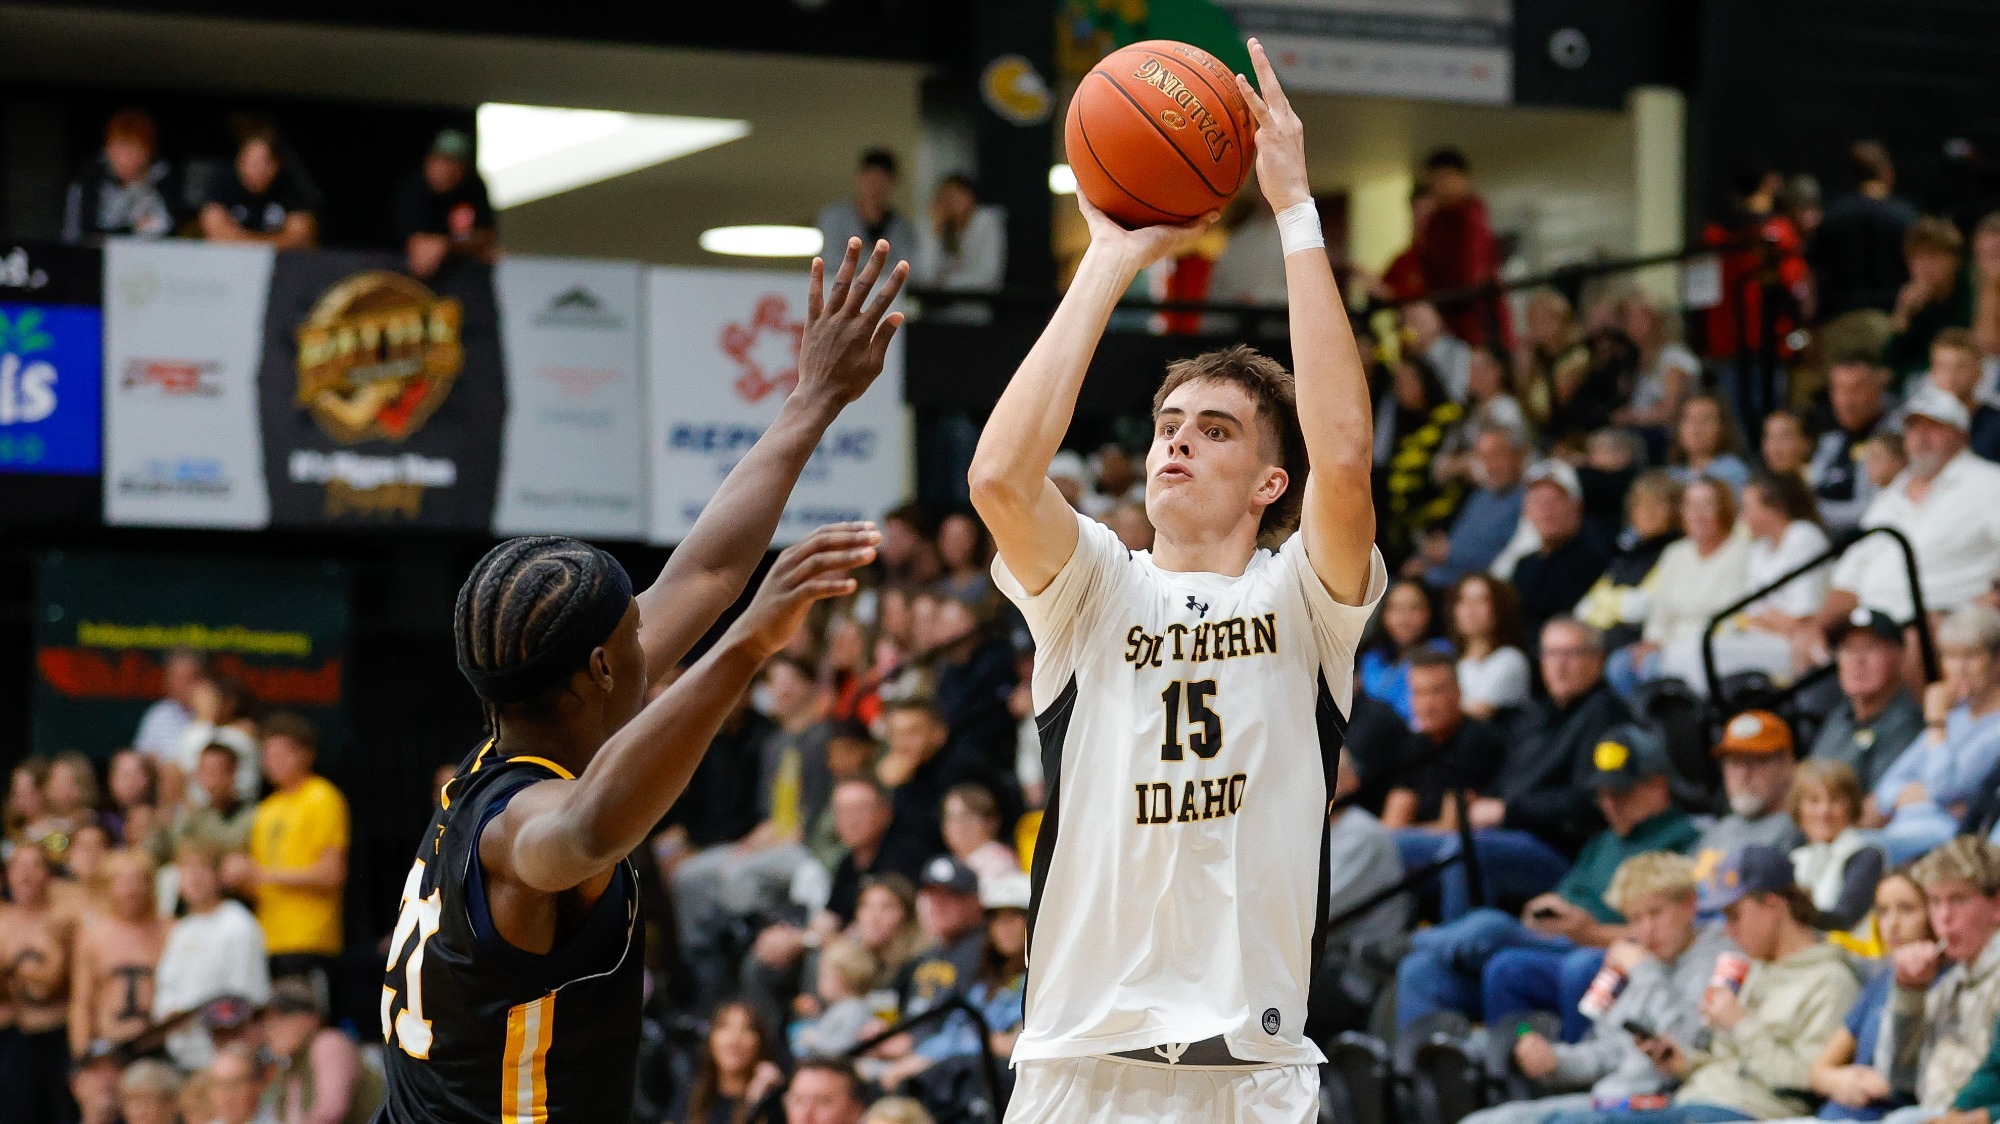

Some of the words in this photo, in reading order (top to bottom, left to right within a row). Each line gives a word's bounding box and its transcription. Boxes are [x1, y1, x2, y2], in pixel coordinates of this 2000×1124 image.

[1133, 57, 1233, 163] SPALDING
[1125, 612, 1278, 670] SOUTHERN
[1161, 679, 1224, 762] 15
[1134, 773, 1248, 826] IDAHO
